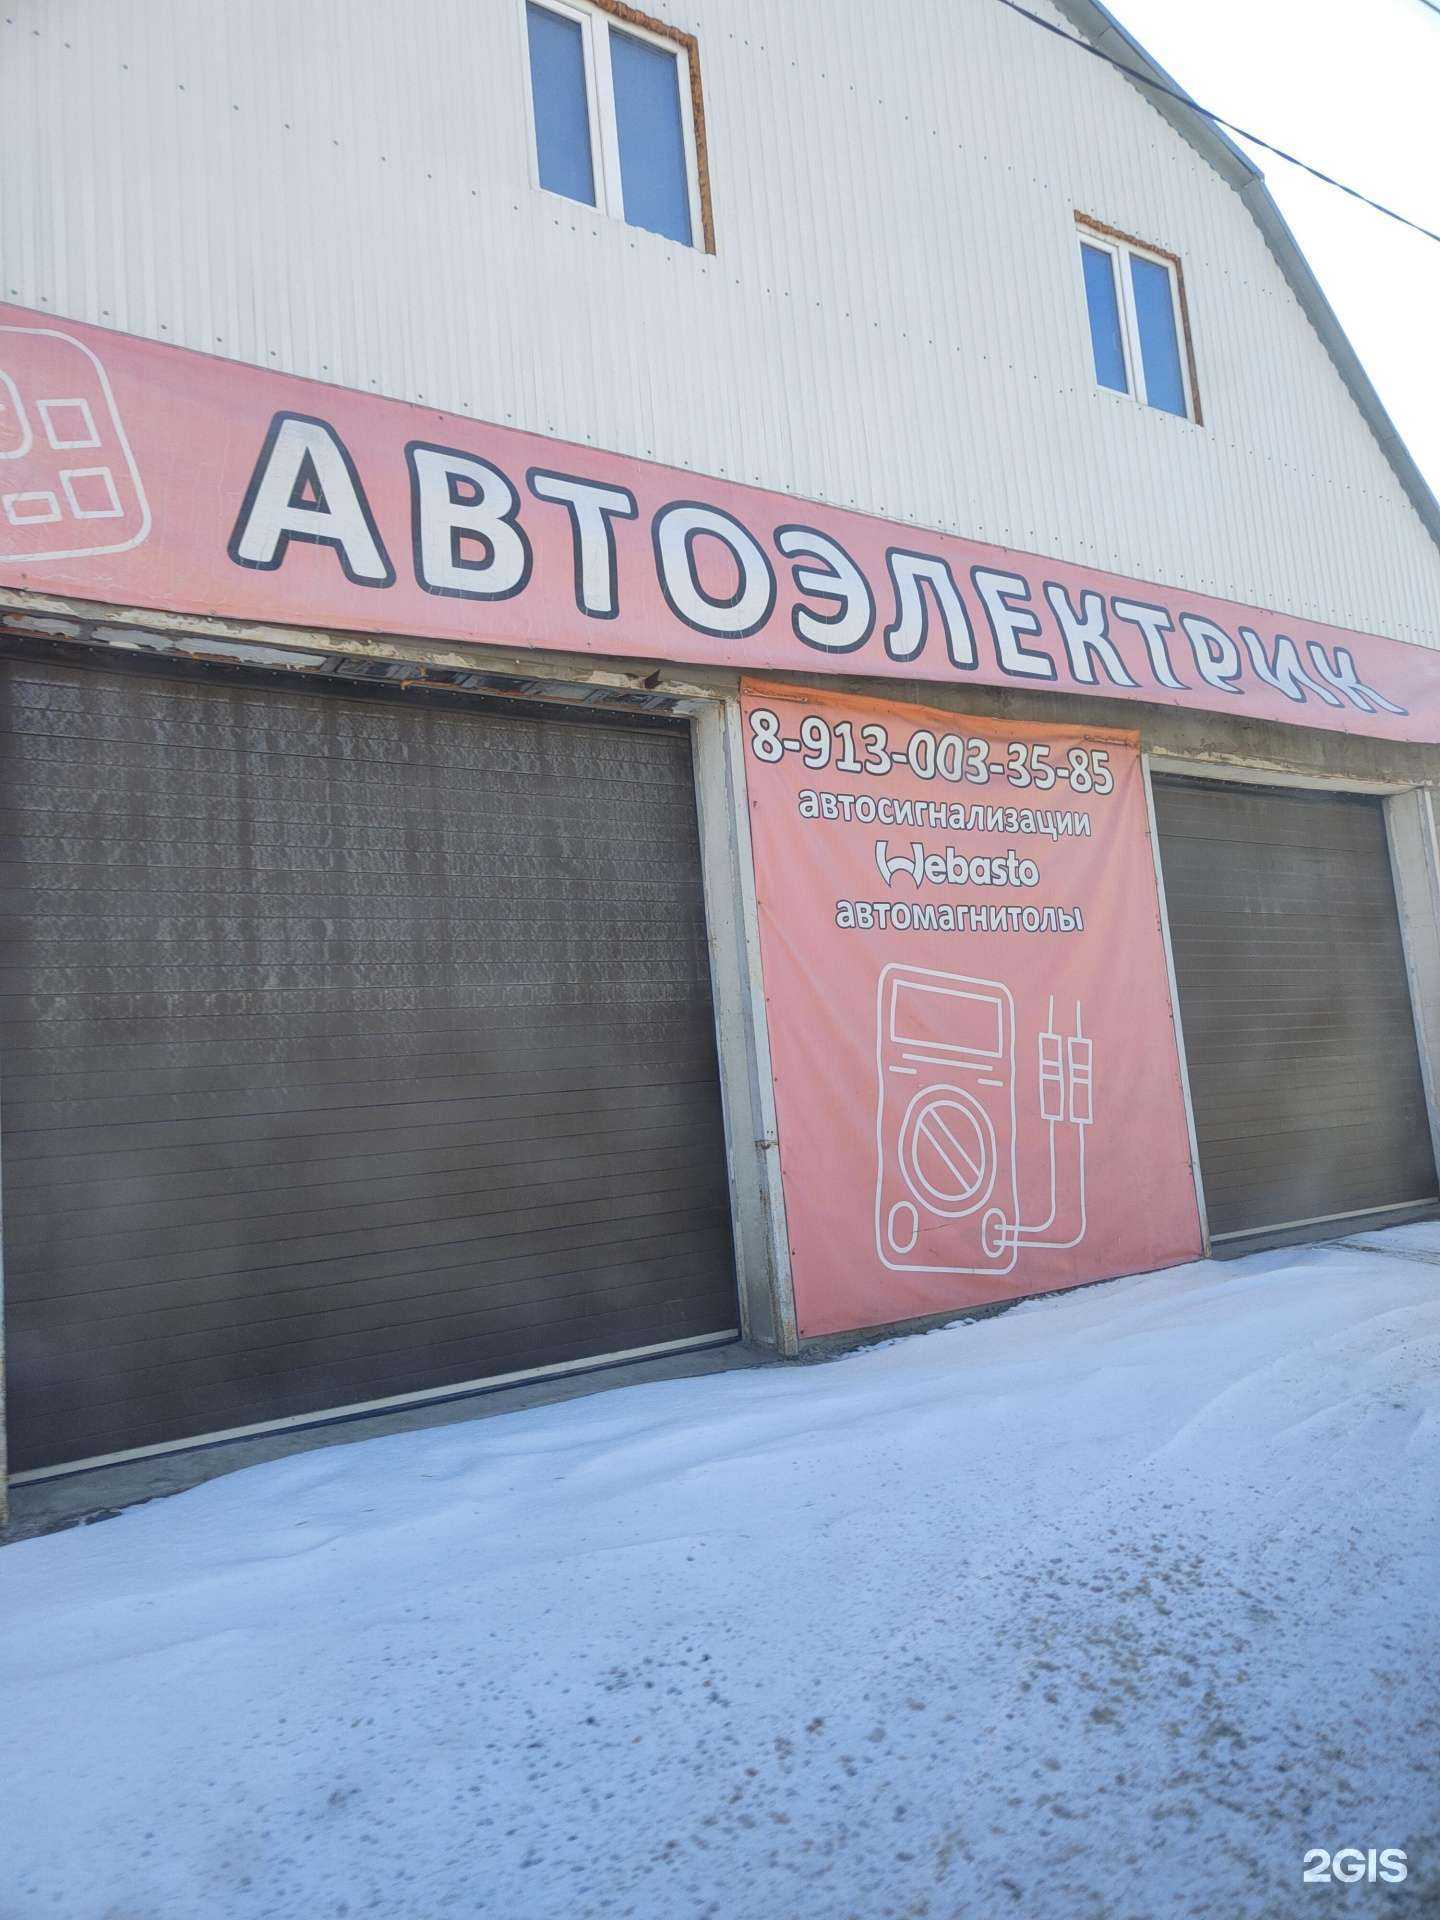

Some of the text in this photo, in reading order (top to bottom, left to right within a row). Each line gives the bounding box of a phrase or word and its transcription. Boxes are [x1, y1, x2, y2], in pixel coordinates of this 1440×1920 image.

[228, 410, 1408, 717] АВТОЭЛЕКТРИК
[749, 708, 1115, 795] 8-913-003-35-85
[798, 789, 1092, 842] автосигнализации
[875, 840, 1040, 889] Webasto
[835, 899, 1085, 932] автомагнитолы
